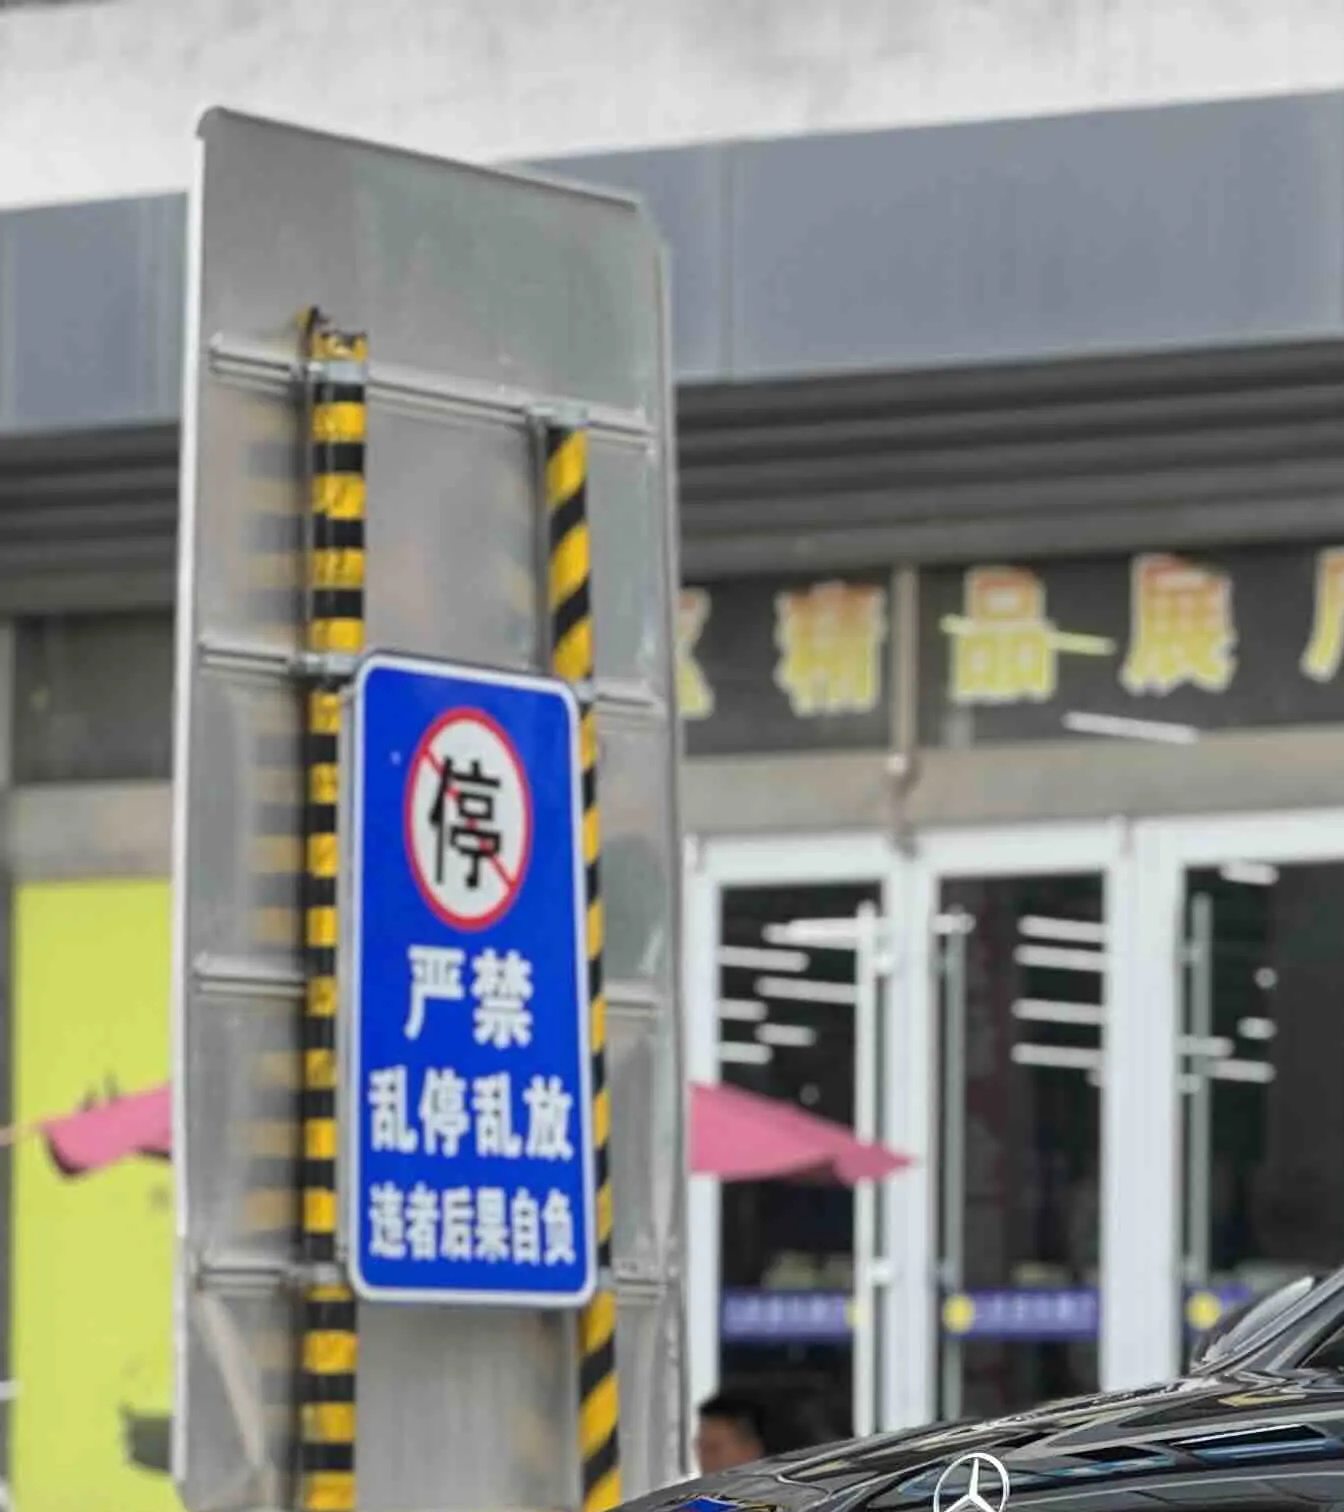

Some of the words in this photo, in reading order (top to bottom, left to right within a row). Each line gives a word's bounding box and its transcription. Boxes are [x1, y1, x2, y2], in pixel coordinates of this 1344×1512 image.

[428, 757, 502, 888] 停
[404, 945, 533, 1048] 严禁
[368, 1065, 574, 1161] 乱停乱放
[368, 1181, 576, 1266] 违者后果自负
